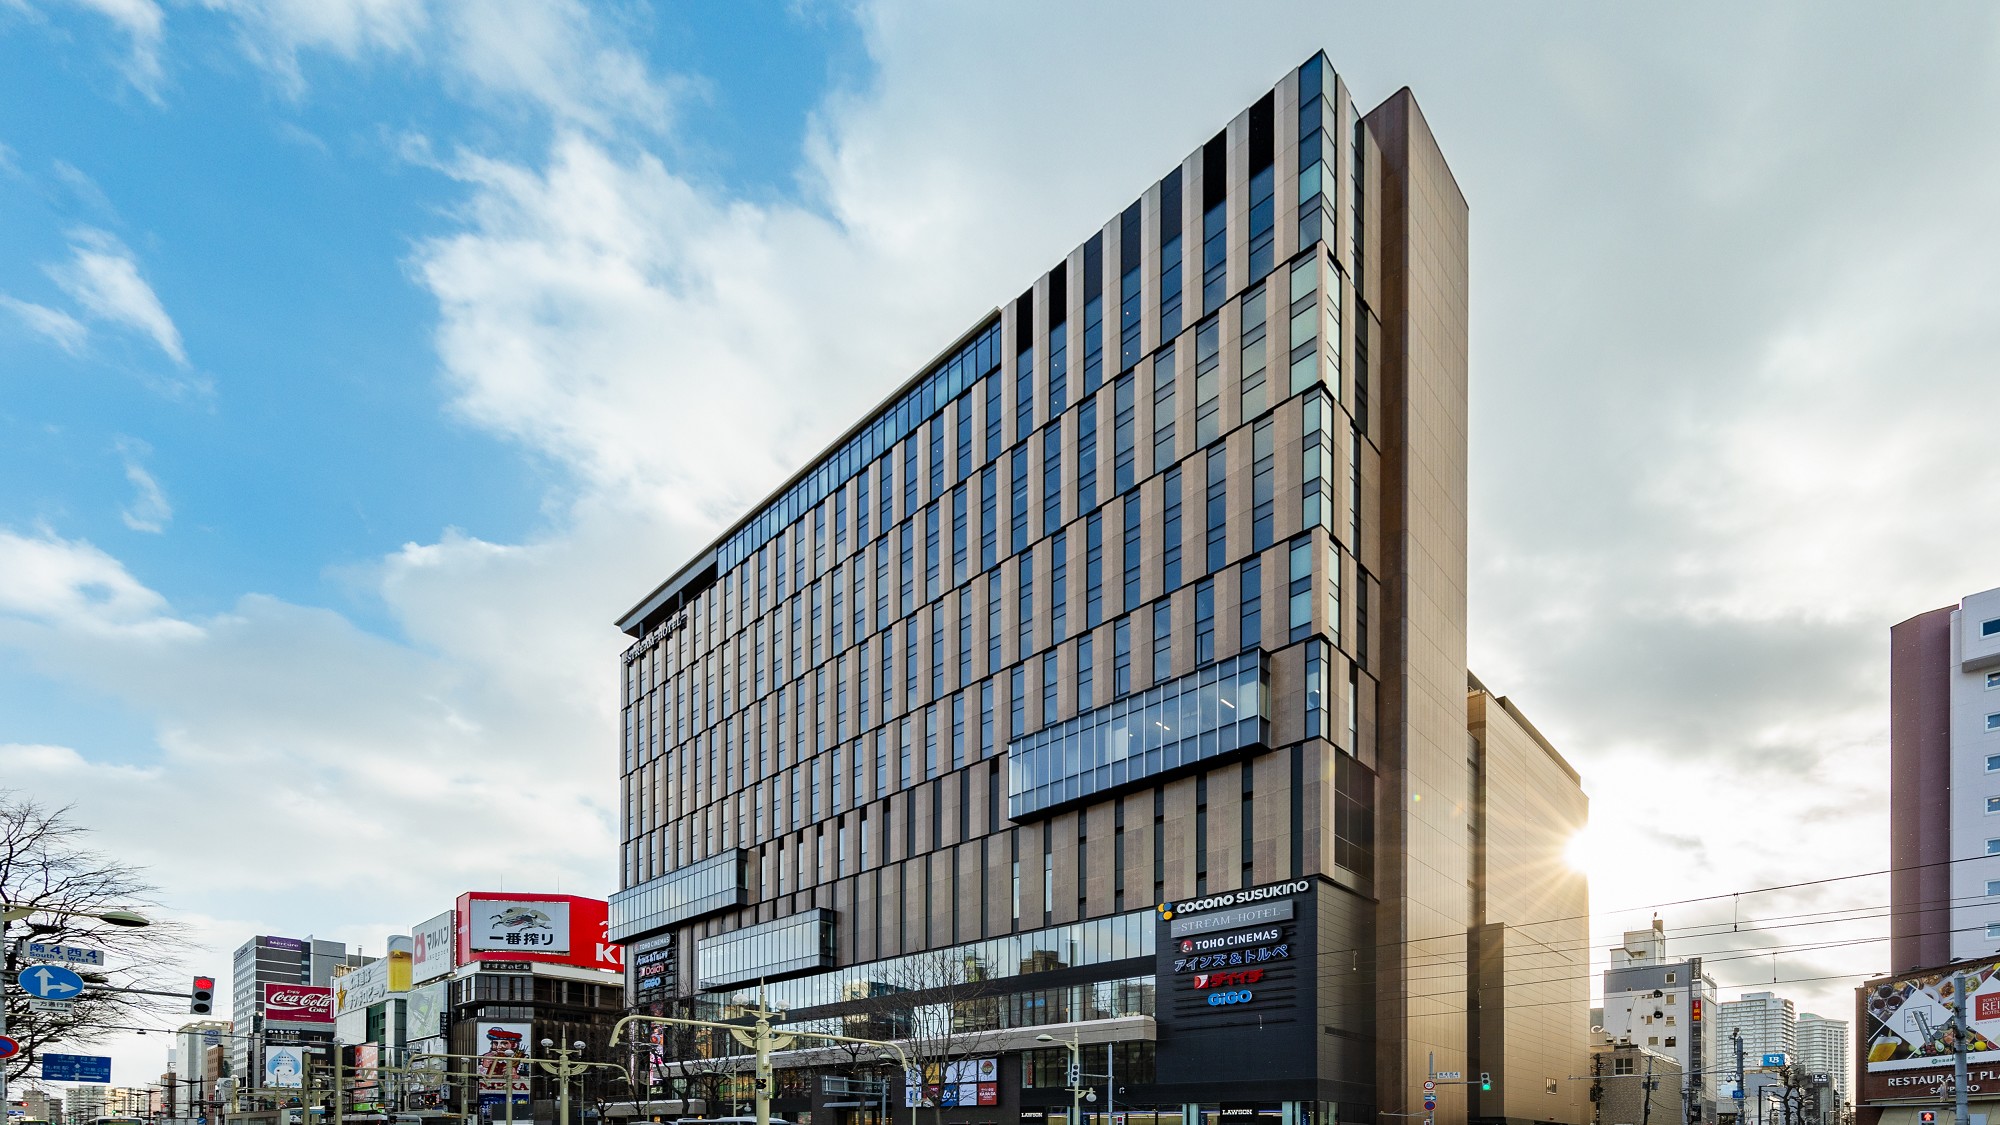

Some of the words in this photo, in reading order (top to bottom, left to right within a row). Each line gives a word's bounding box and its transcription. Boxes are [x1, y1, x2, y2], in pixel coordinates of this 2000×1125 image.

[1176, 894, 1234, 914] COCONO
[1235, 880, 1309, 904] SUSUKINO
[1181, 916, 1231, 932] STREAM
[1238, 909, 1280, 923] HOTEL
[270, 940, 299, 948] Mercure
[426, 925, 449, 951] マルハン
[489, 932, 554, 946] 一番搾り
[640, 942, 650, 950] TOHO
[651, 936, 670, 947] CINEMAS
[1195, 937, 1225, 950] TOHO
[1227, 929, 1278, 945] CINEMAS
[1209, 968, 1264, 987] ダイイチ
[1888, 1071, 1976, 1087] RESTAURAT
